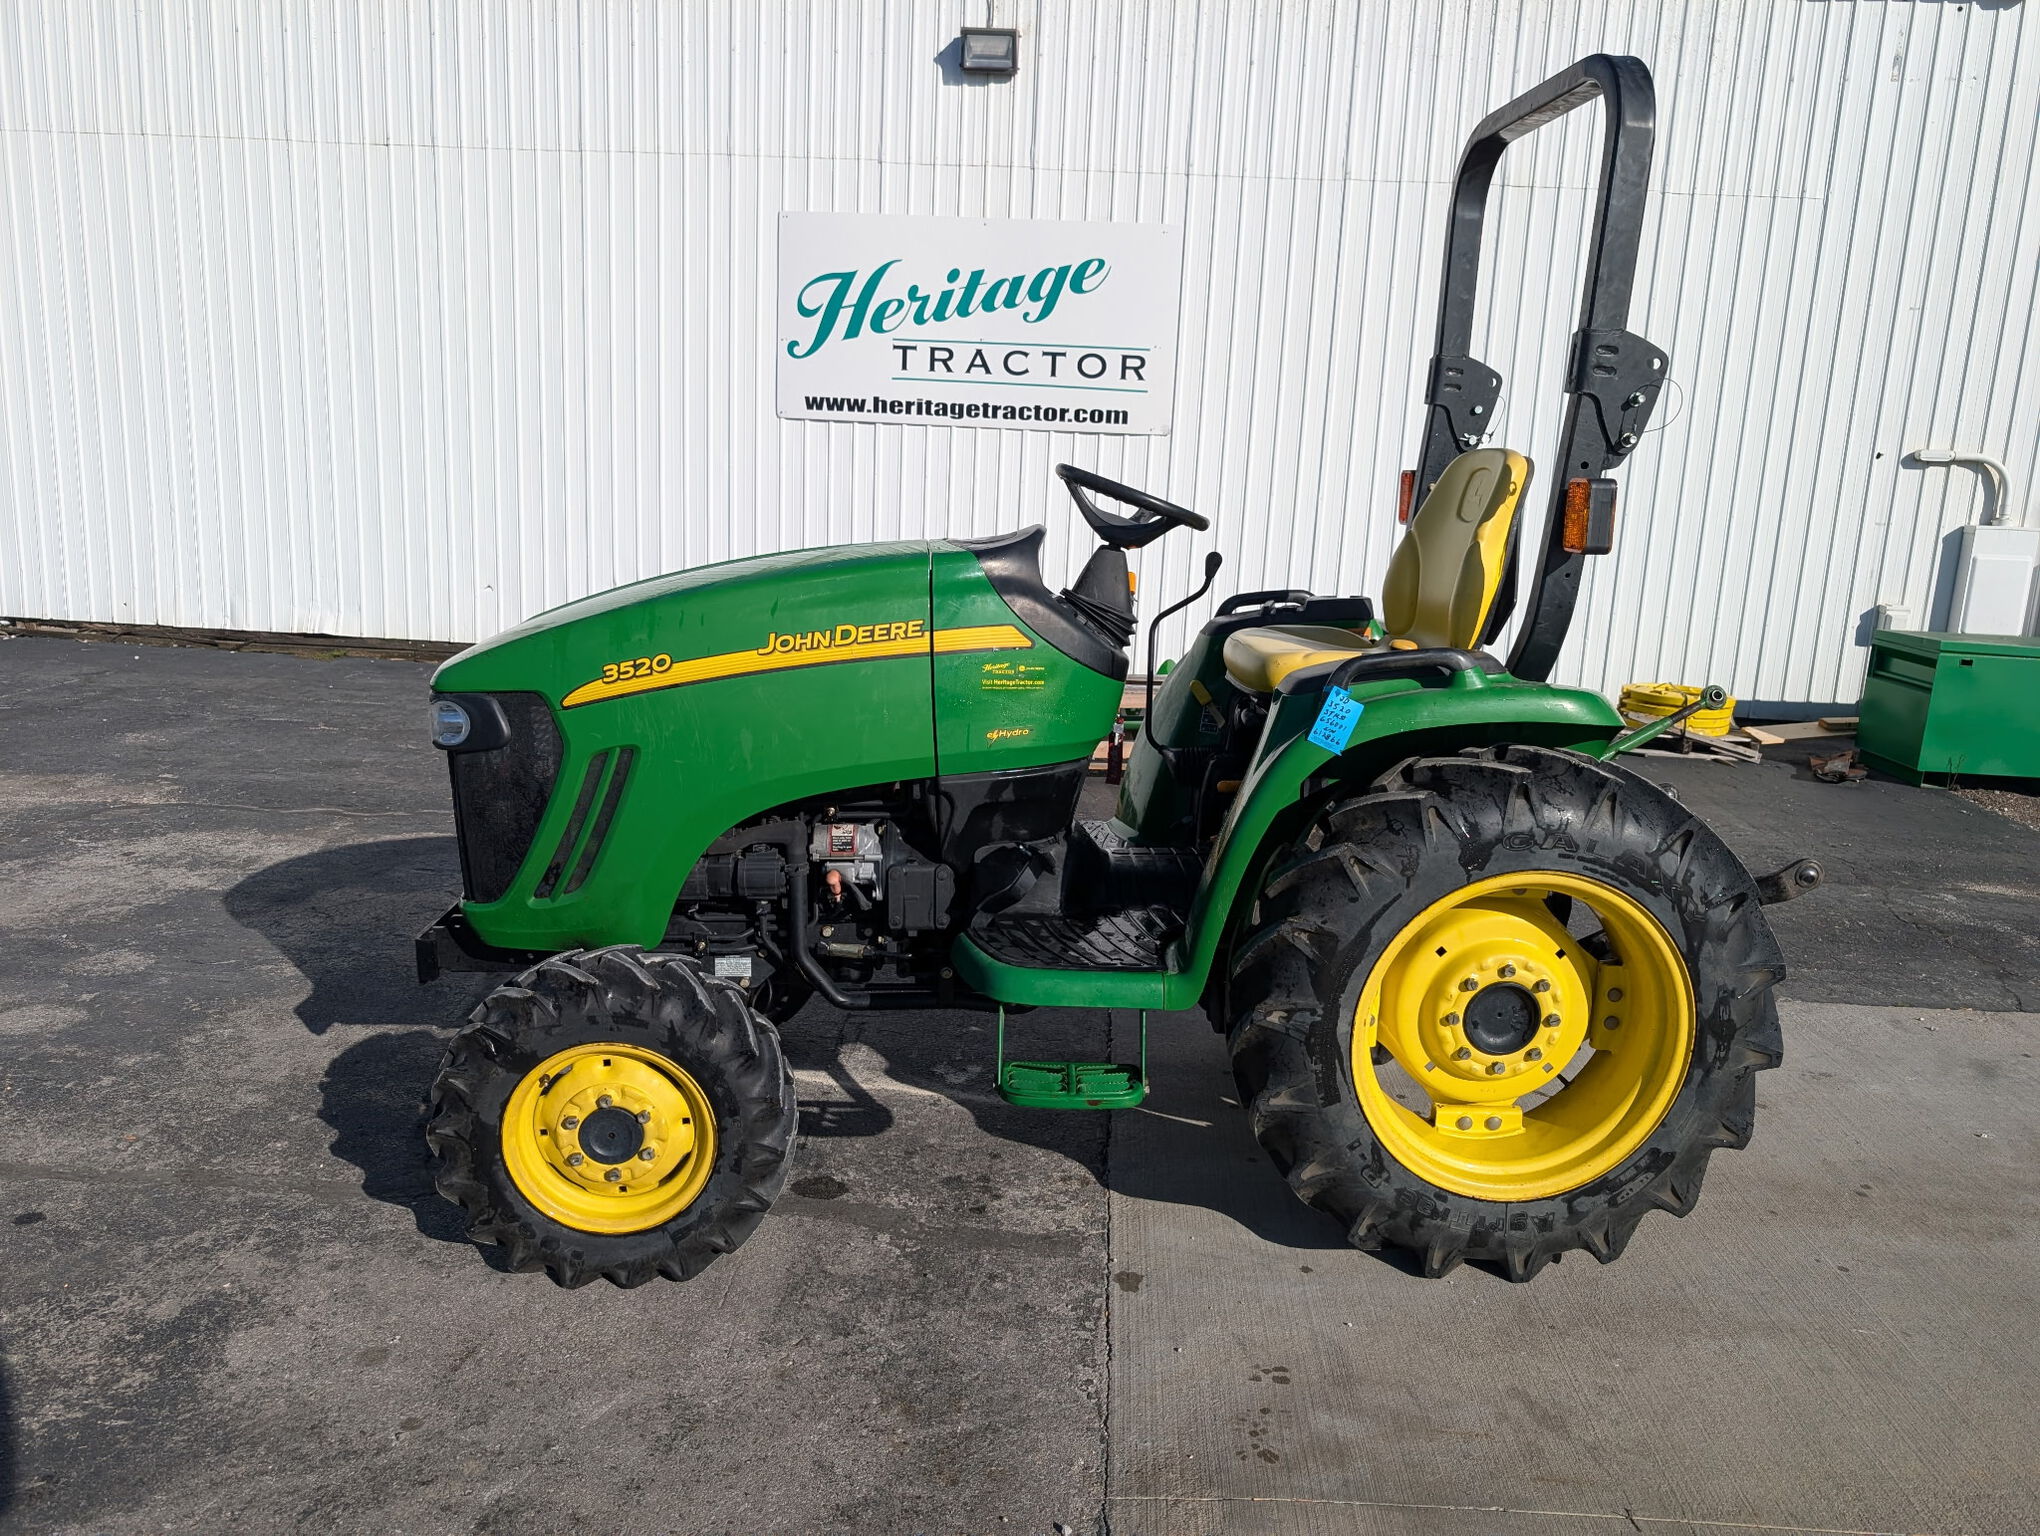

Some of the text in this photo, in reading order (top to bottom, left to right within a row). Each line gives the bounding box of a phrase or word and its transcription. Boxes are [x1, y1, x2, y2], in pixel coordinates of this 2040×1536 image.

[787, 257, 1111, 359] Heritage
[892, 344, 1146, 381] TRACTOR
[805, 396, 1129, 425] www.heritagetractor.com
[757, 619, 925, 656] JOHN DEERE
[602, 652, 673, 684] 3520
[1328, 700, 1351, 714] 3520
